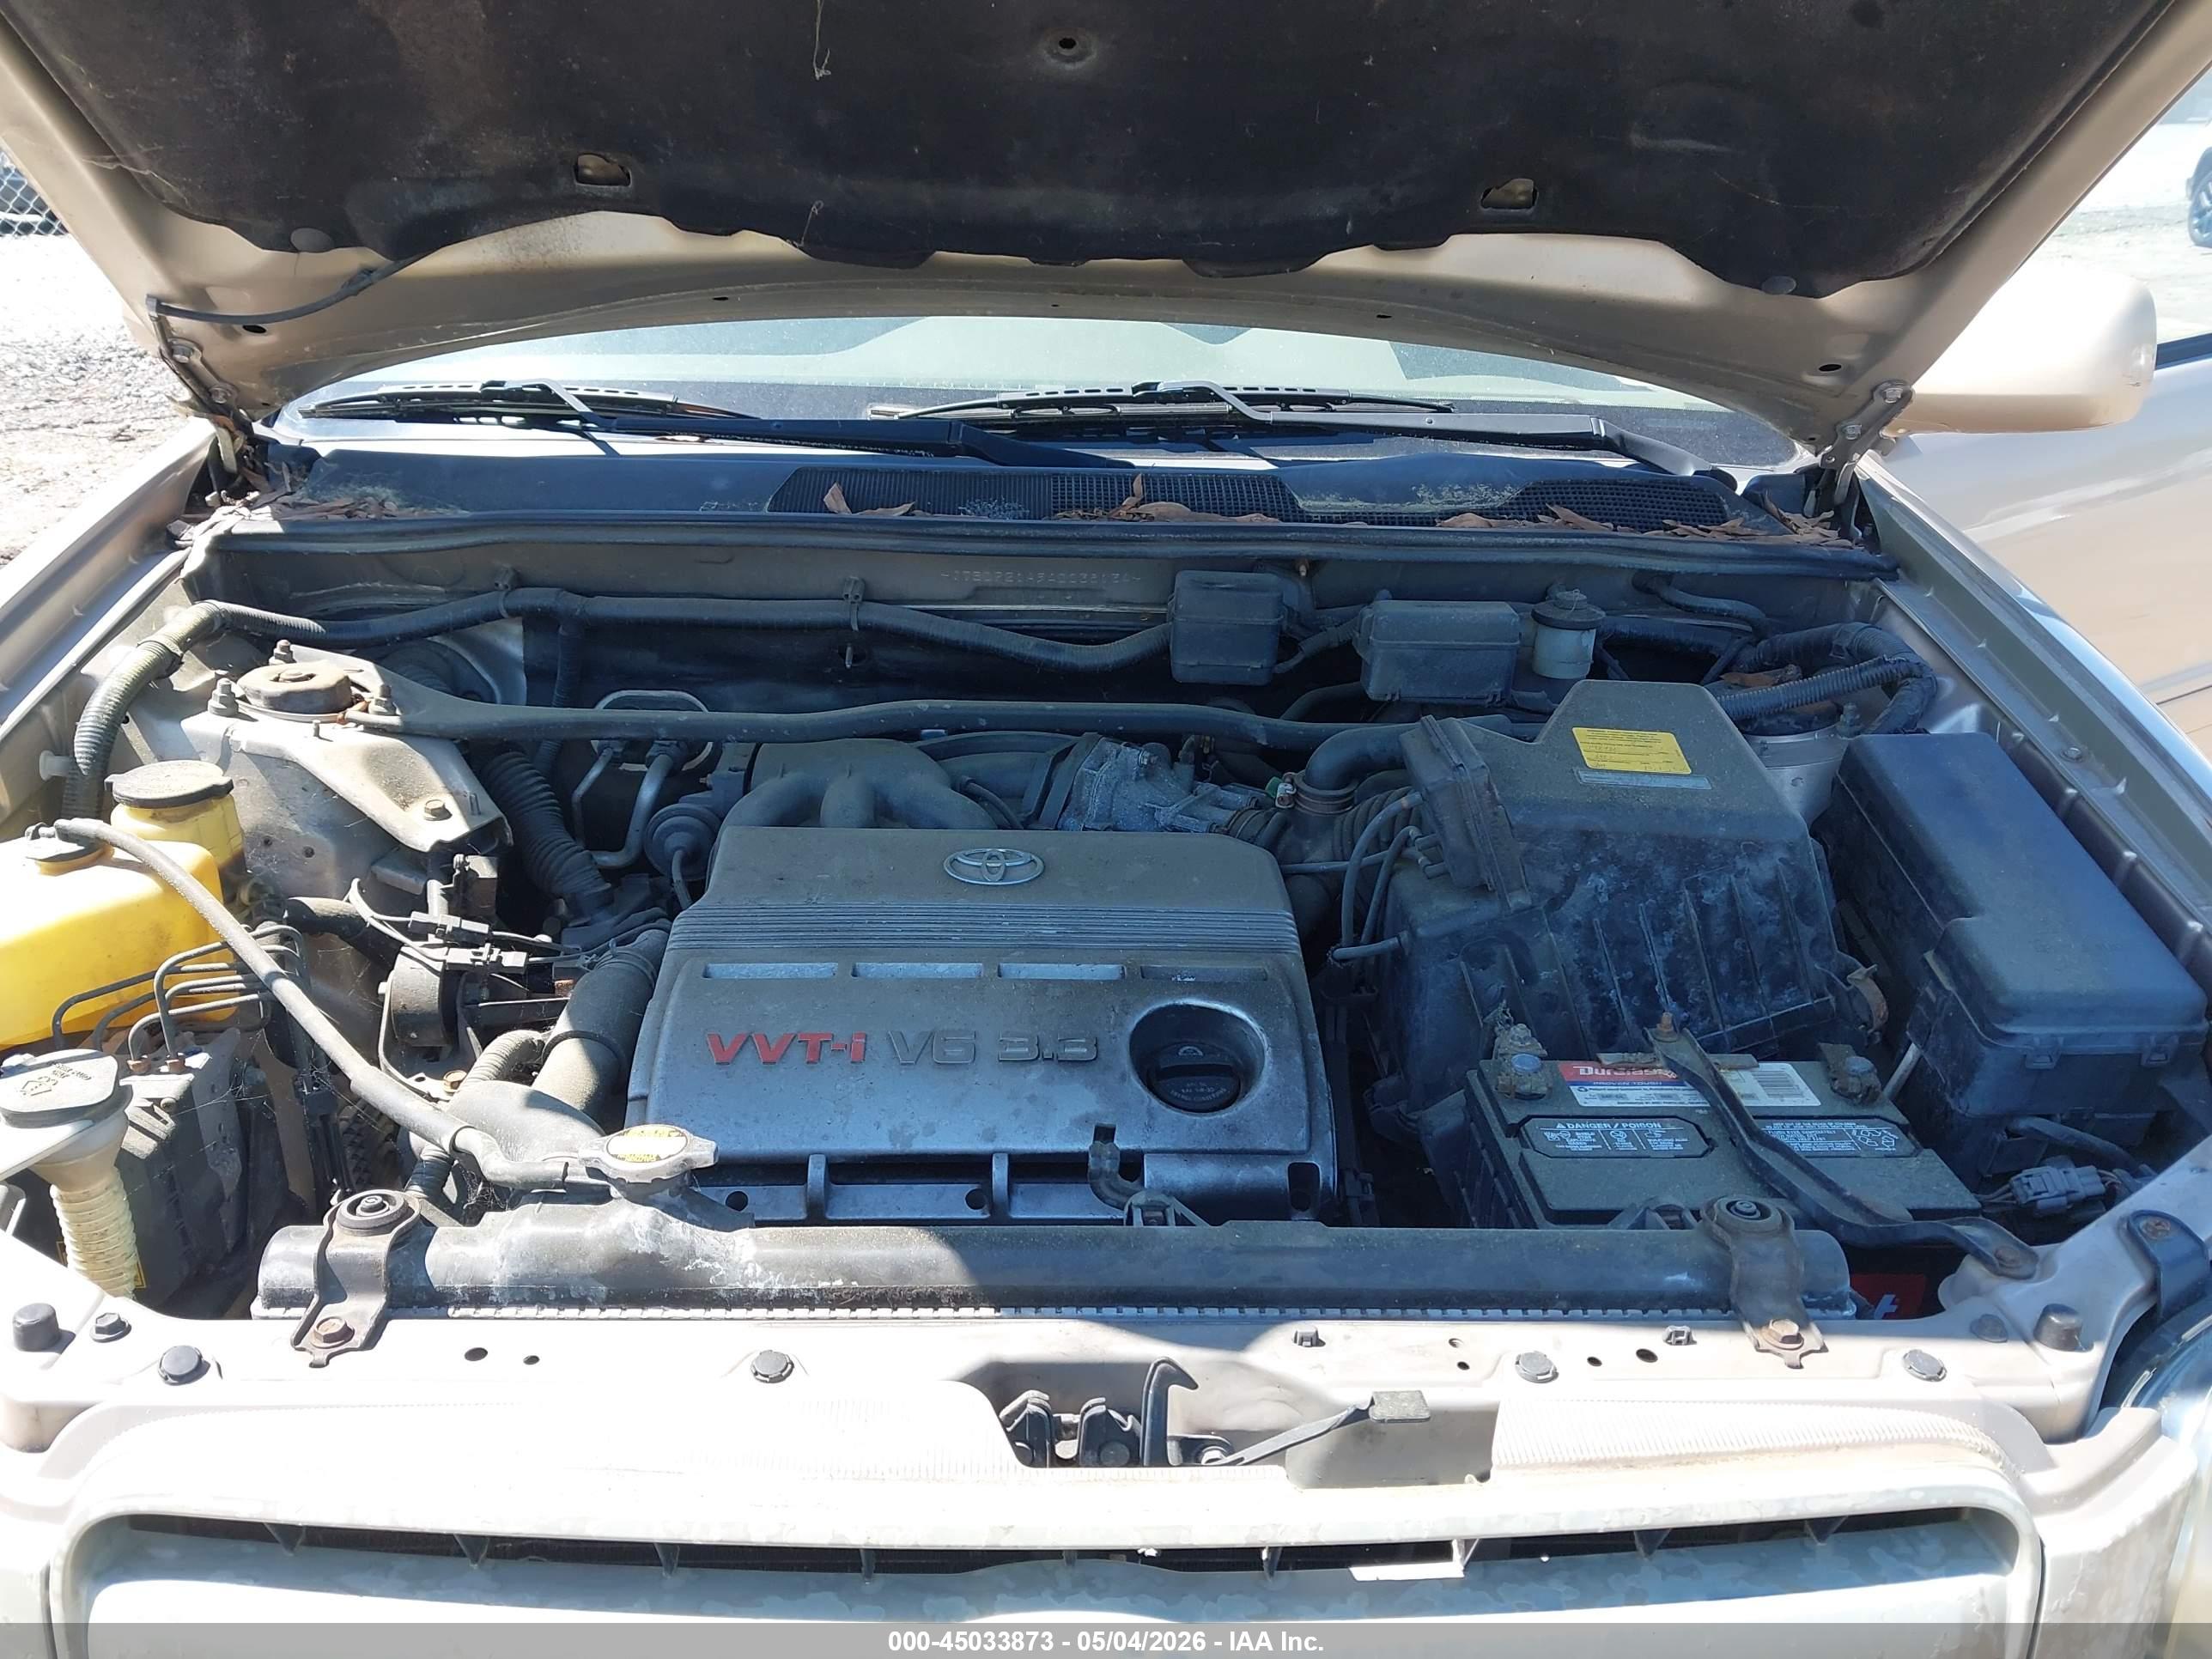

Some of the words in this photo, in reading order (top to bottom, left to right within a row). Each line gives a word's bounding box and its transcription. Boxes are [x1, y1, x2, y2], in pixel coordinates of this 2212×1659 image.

[707, 1031, 867, 1065] VVT-i
[888, 1030, 977, 1065] V6
[998, 1031, 1098, 1063] 3.3
